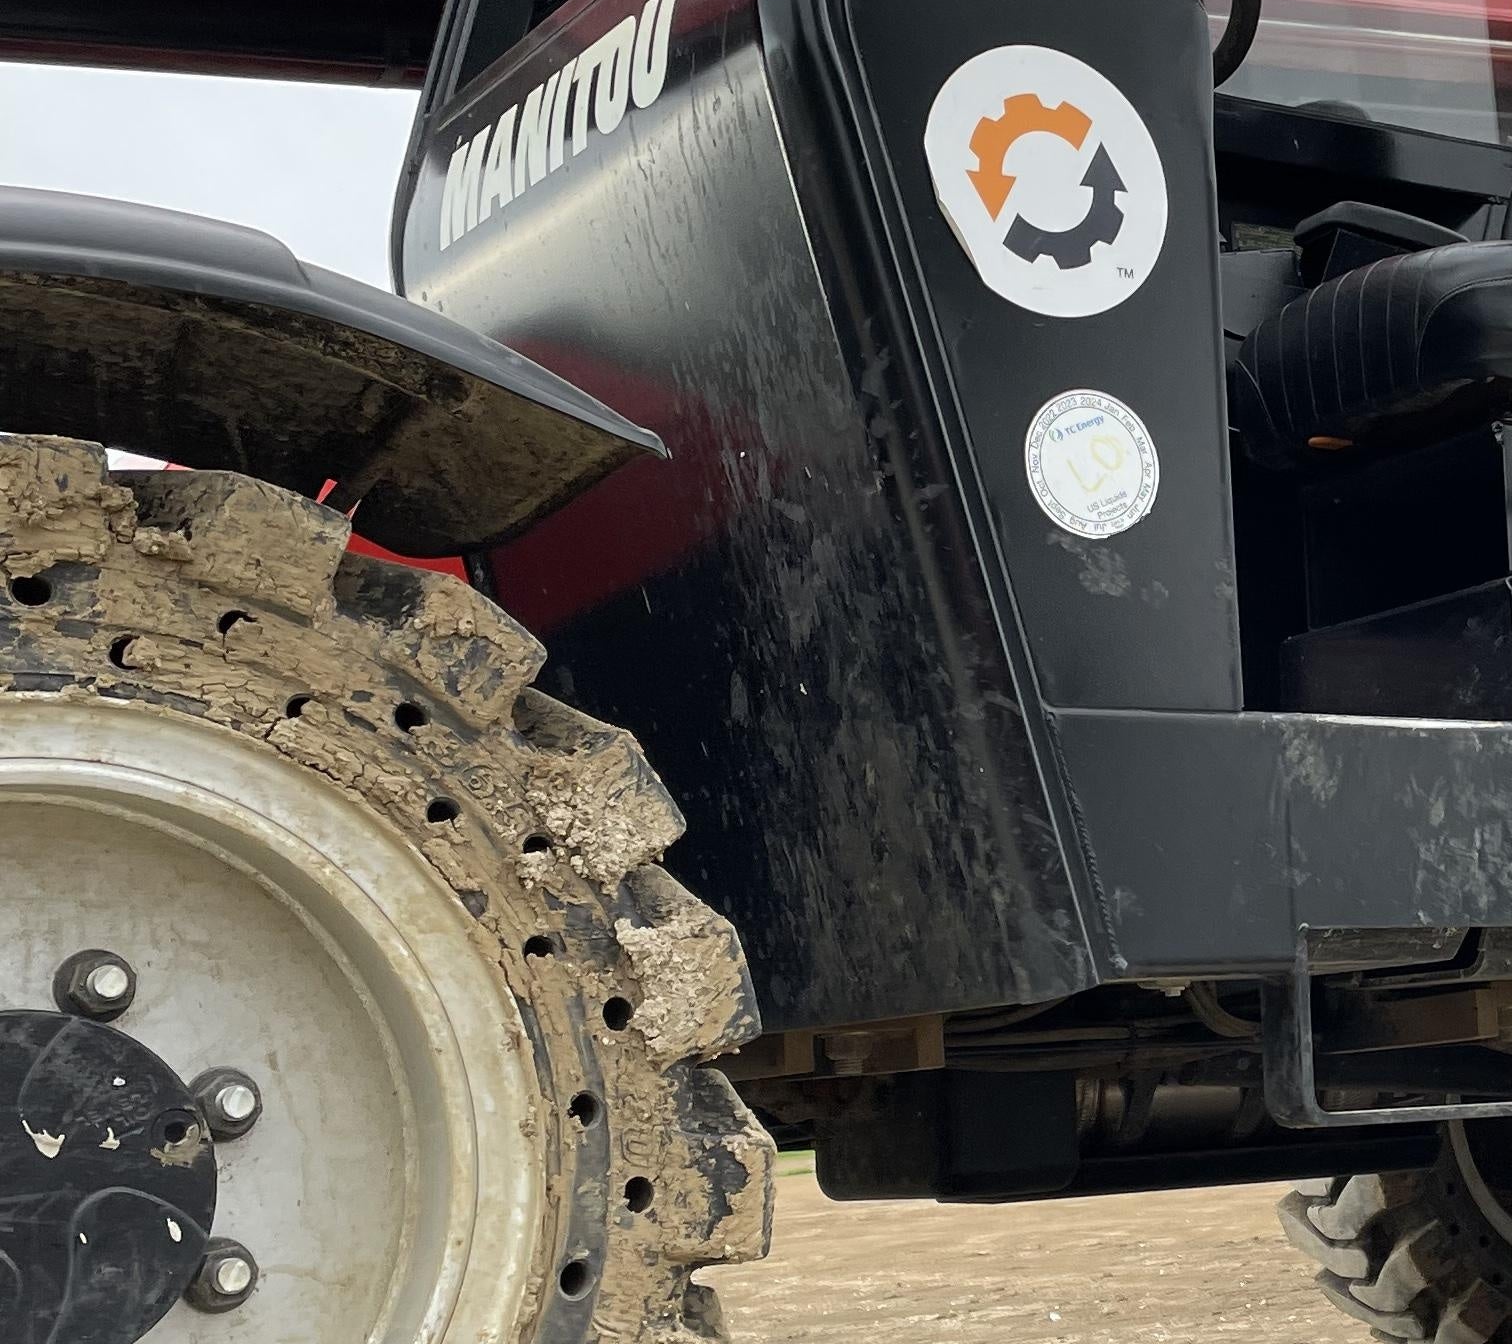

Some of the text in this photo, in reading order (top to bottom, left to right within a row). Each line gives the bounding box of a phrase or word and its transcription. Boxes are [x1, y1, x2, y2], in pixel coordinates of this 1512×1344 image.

[1116, 267, 1134, 280] TM
[1065, 414, 1105, 436] TC Energy
[1030, 397, 1154, 532] 2022 2023 2024 Jan Feb Mar Apr May Jun Jul Aug Sept Oct Nov Dec
[1087, 490, 1128, 513] US Liquids
[1097, 502, 1129, 520] Projects
